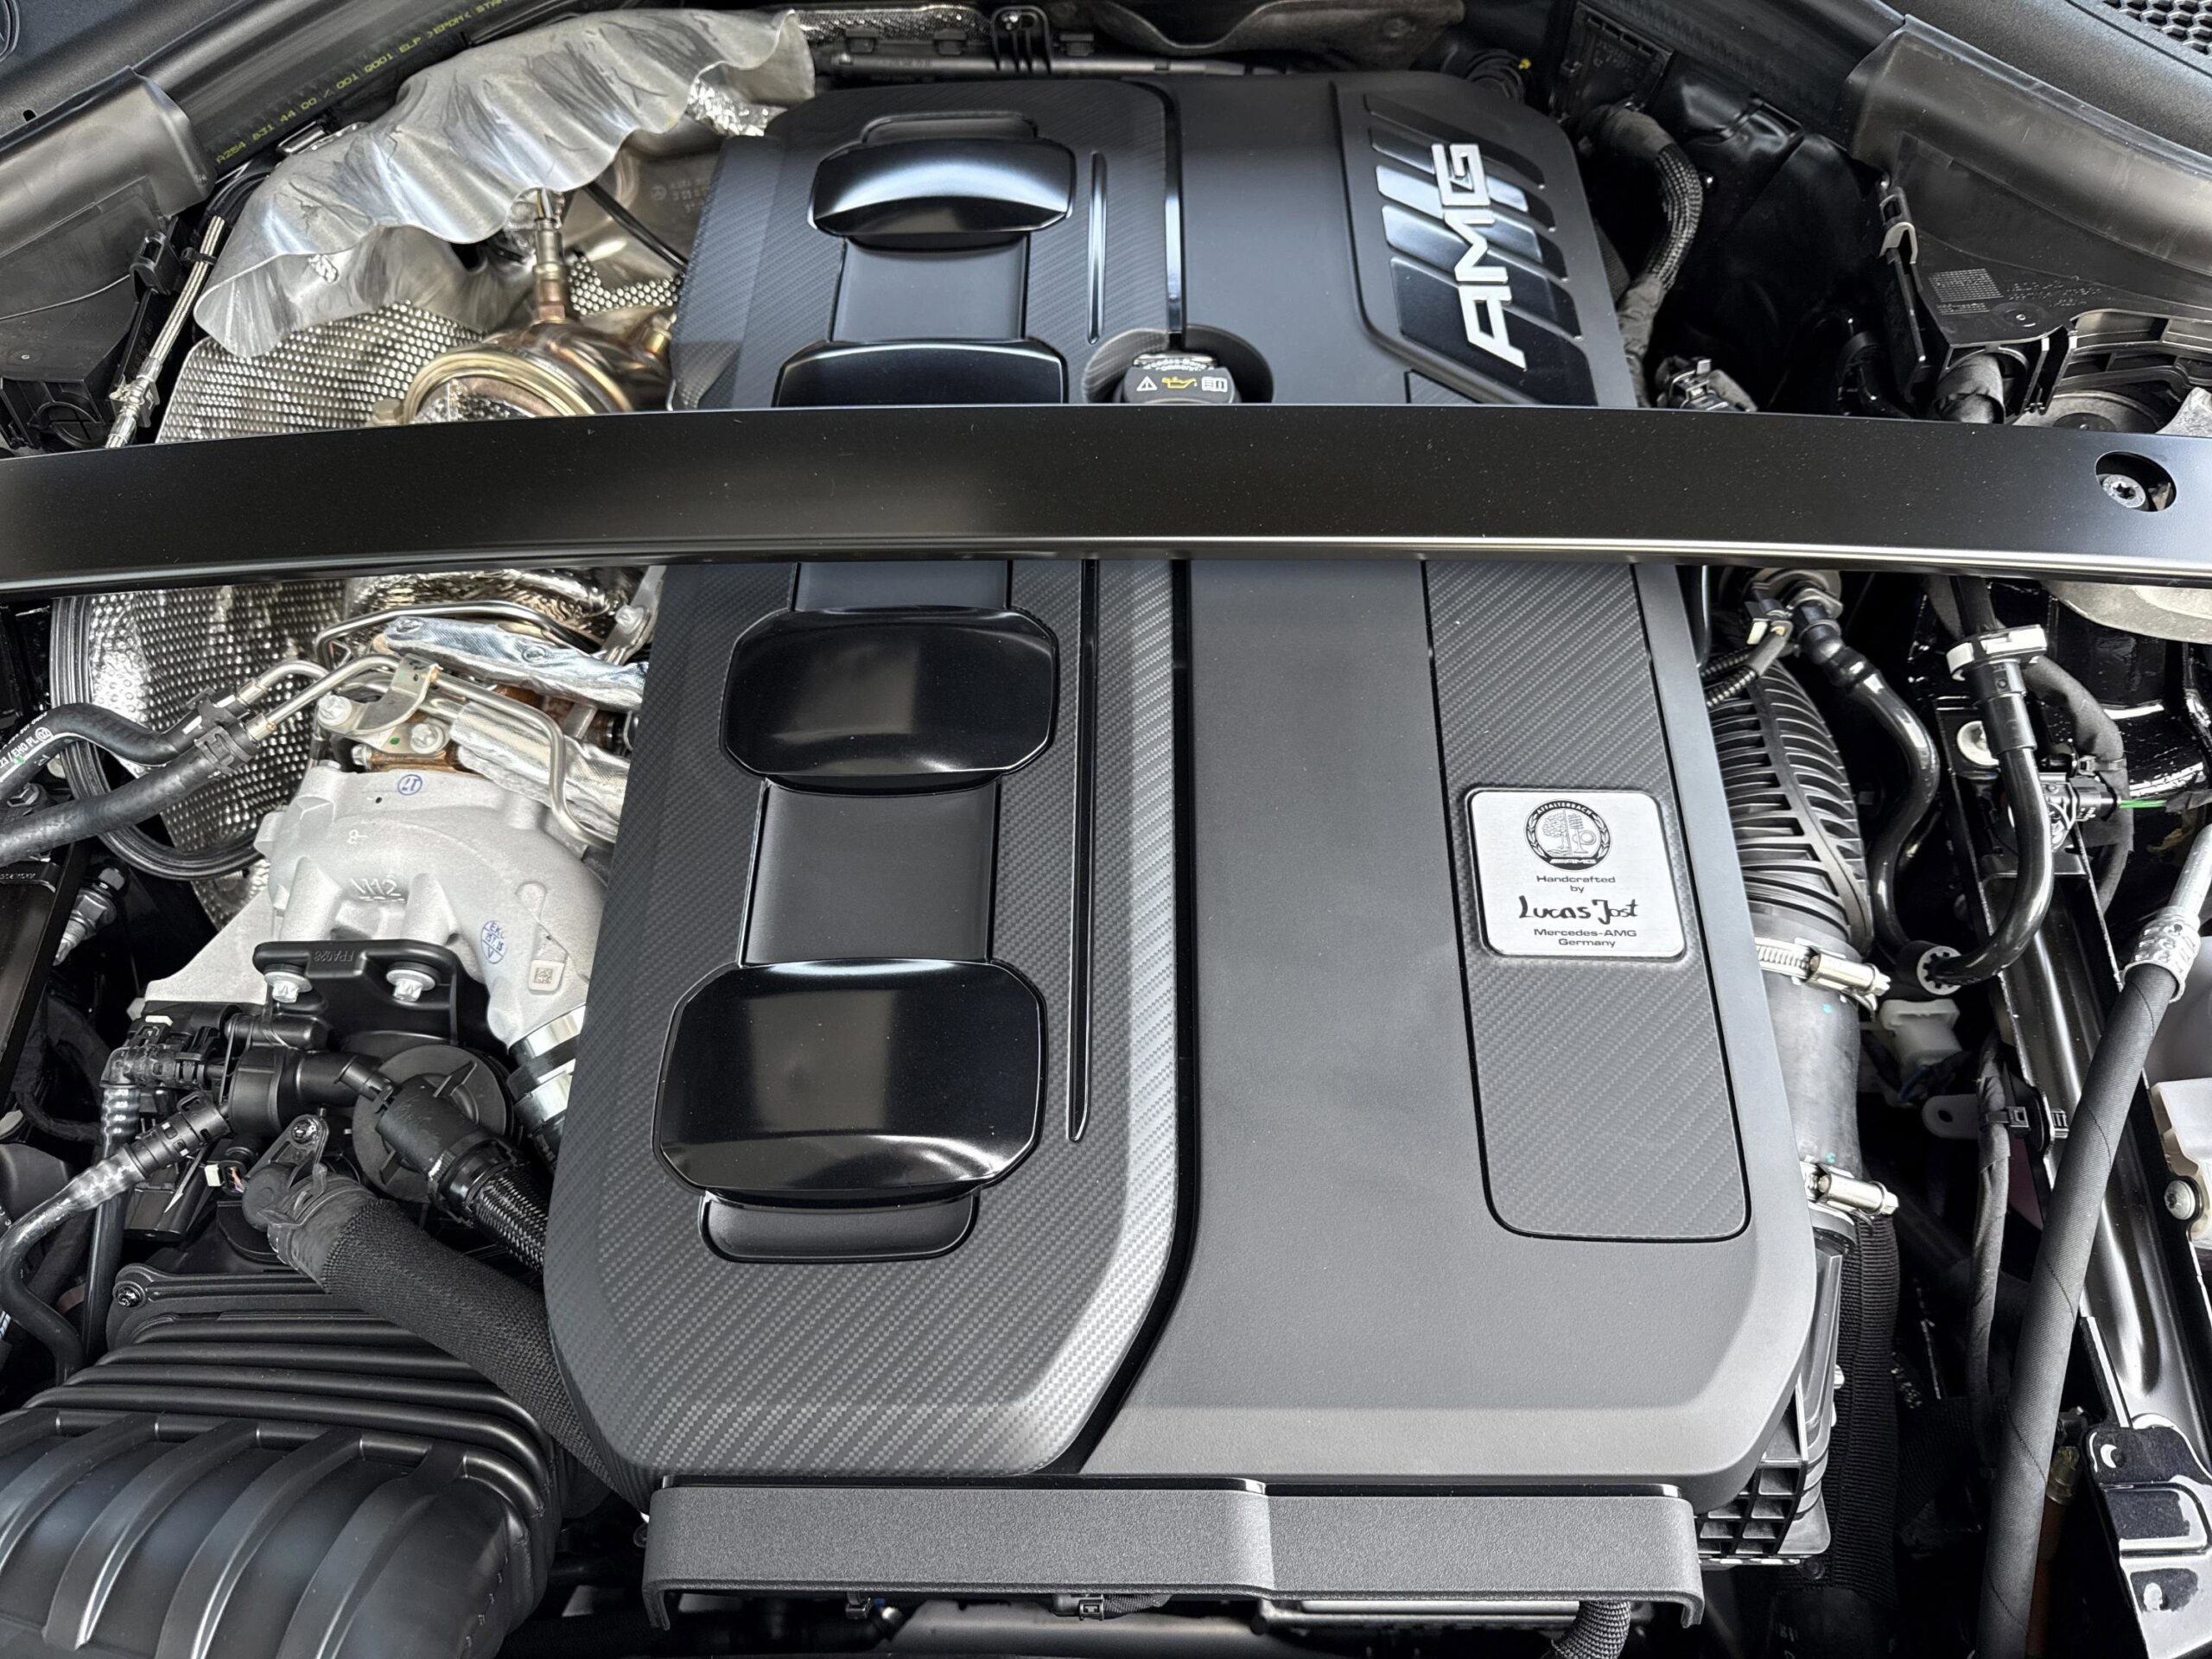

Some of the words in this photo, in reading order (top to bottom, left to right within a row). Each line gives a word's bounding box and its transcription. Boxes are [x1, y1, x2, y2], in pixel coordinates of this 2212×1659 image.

[216, 141, 246, 164] A254
[279, 110, 296, 123] 44
[1431, 143, 1528, 372] AMG
[1569, 885, 1585, 893] by
[1518, 895, 1592, 918] Lucas
[1591, 899, 1639, 925] Jost
[1534, 928, 1637, 938] Mercedes-AMG
[1558, 938, 1616, 948] Germany
